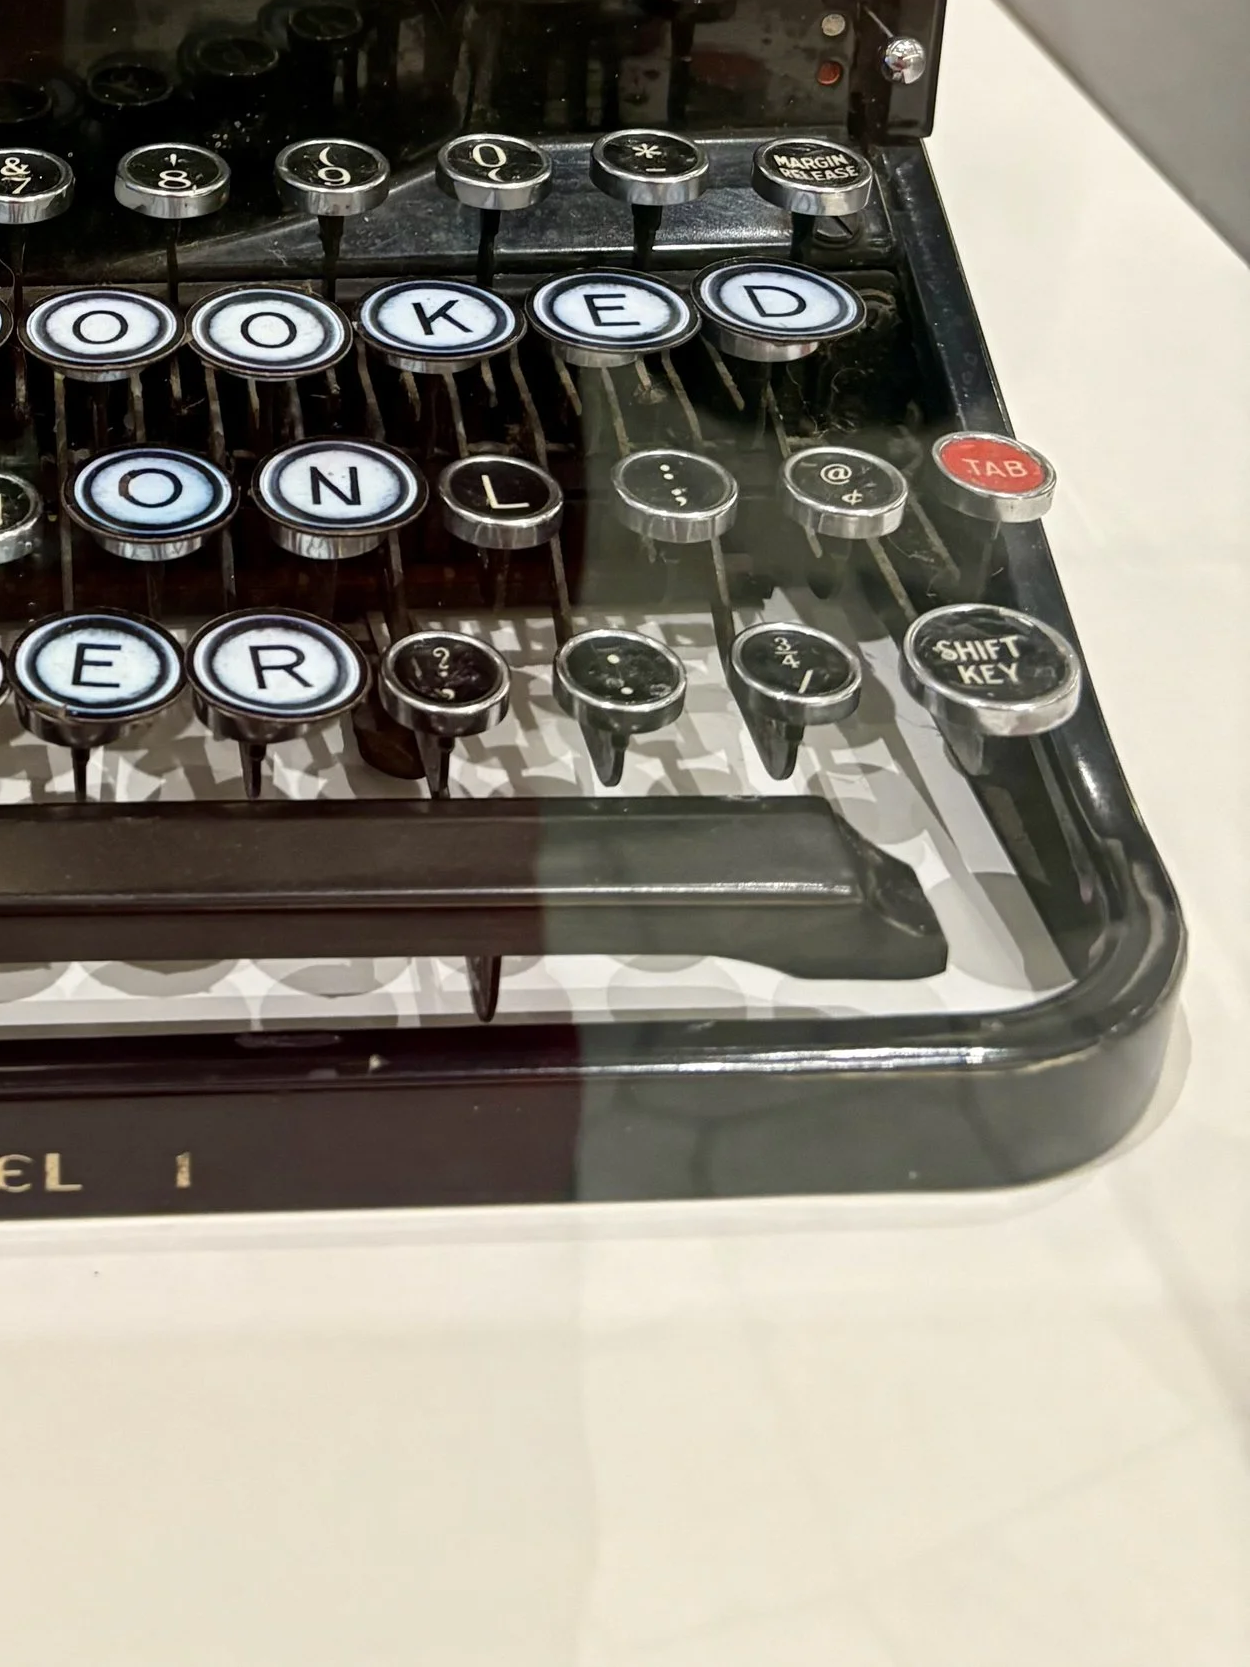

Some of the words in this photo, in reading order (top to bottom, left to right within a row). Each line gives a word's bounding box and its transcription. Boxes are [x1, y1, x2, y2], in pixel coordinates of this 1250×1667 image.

[0, 157, 31, 177] &
[318, 166, 351, 186] 9
[773, 153, 849, 171] MARGIN
[780, 166, 860, 181] RELEASE
[1, 177, 32, 195] 7
[157, 169, 192, 190] 8
[583, 293, 641, 327] E
[743, 284, 807, 318] D
[72, 309, 129, 345] O
[239, 311, 298, 349] O
[411, 299, 473, 336] K
[820, 463, 852, 485] @
[961, 457, 1028, 479] TAB
[118, 467, 184, 509] O
[308, 465, 363, 506] N
[482, 474, 530, 510] L
[432, 647, 450, 677] ?
[934, 636, 1021, 661] SHIFT
[70, 642, 123, 688] E
[247, 643, 314, 690] R
[956, 660, 1019, 686] KEY
